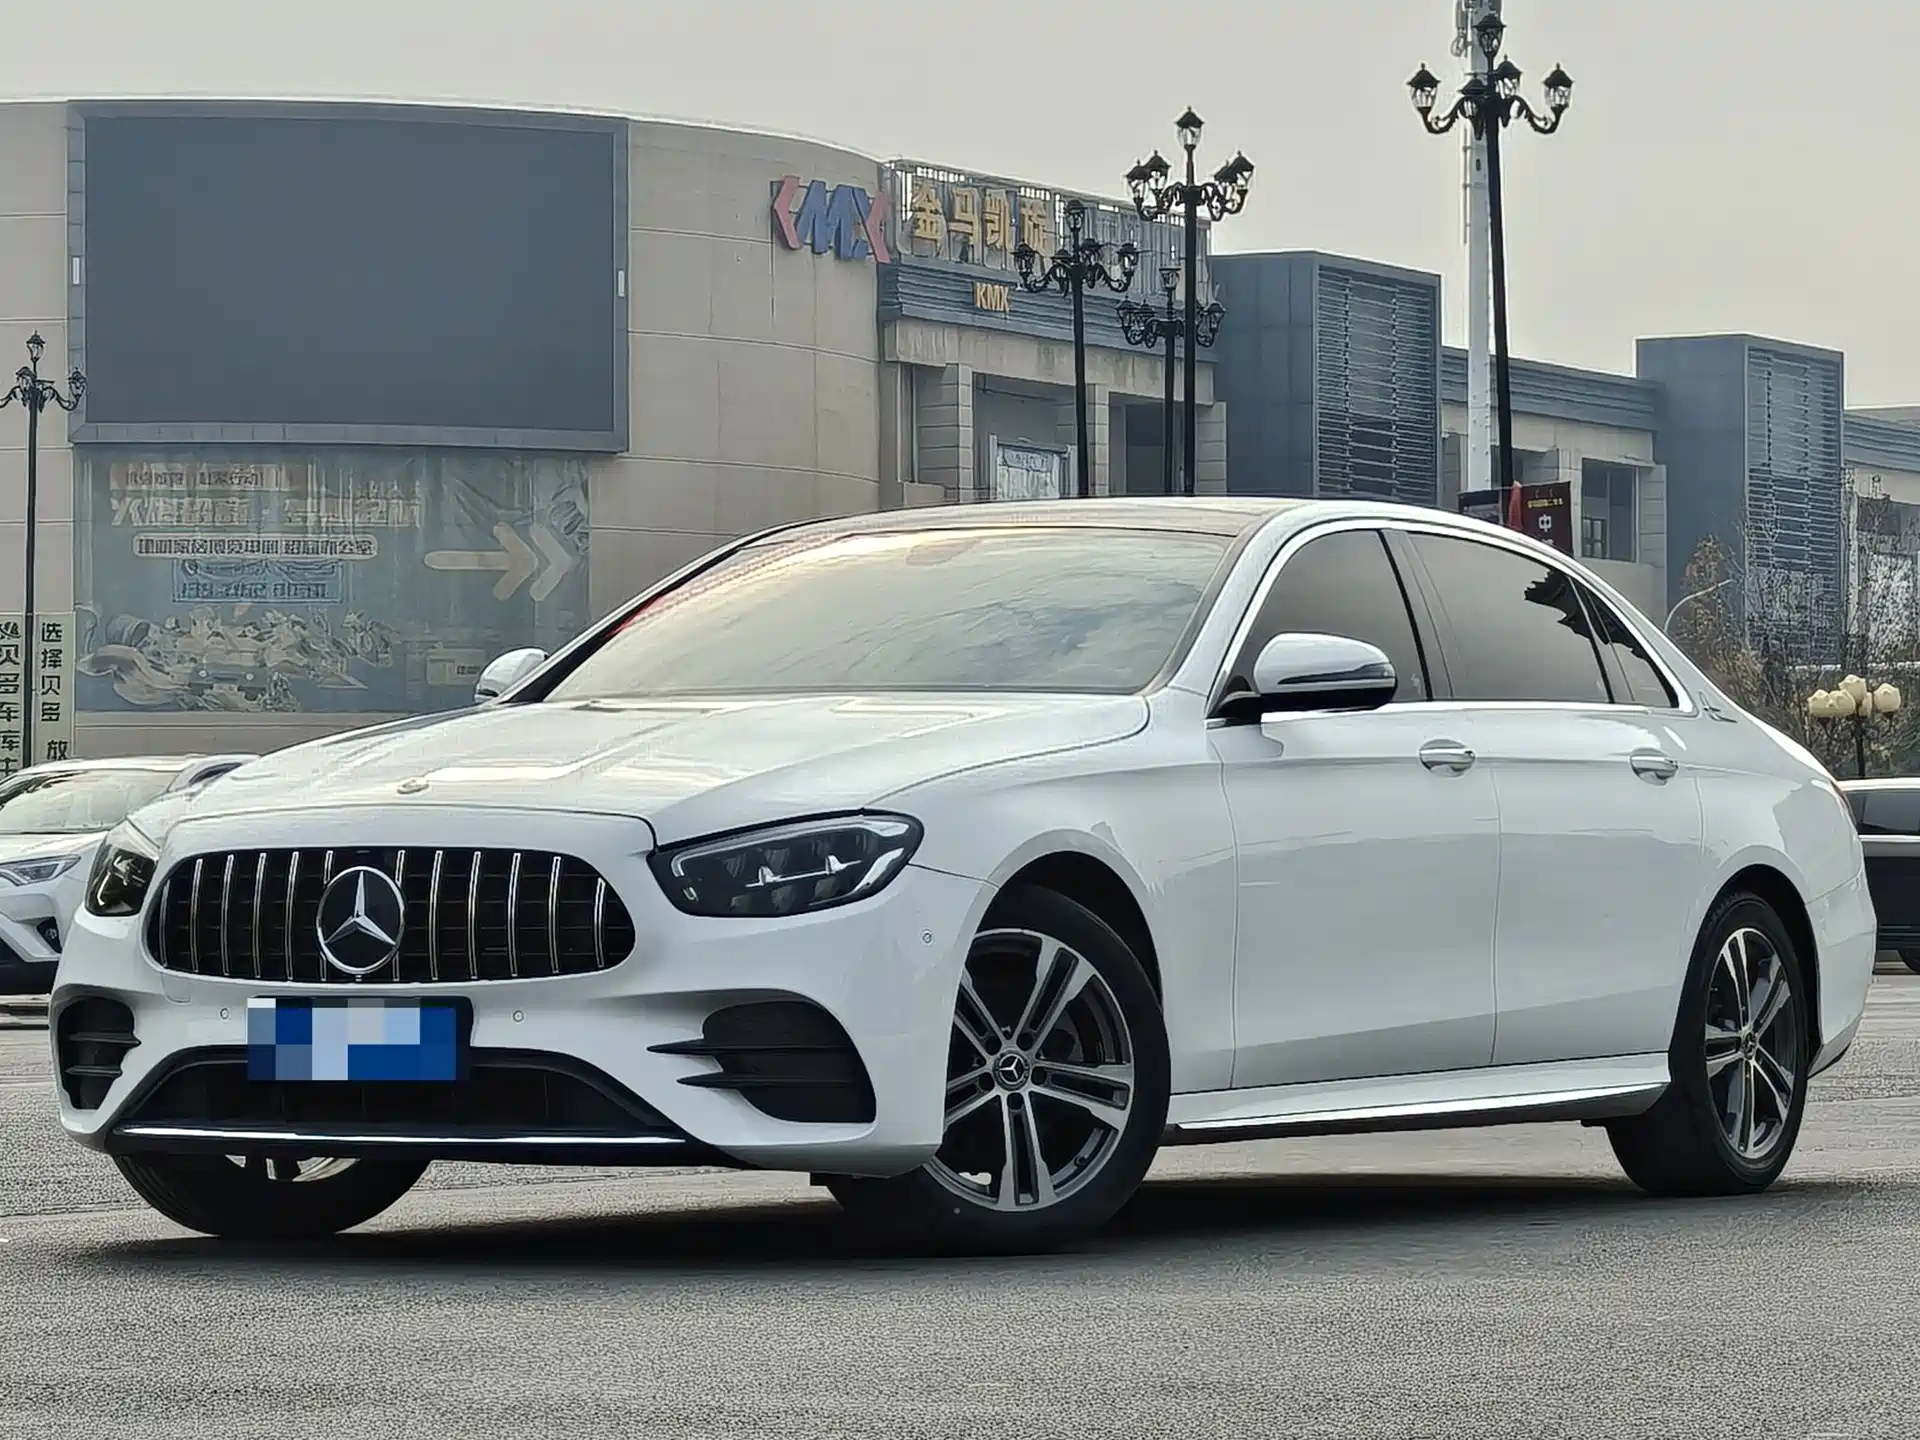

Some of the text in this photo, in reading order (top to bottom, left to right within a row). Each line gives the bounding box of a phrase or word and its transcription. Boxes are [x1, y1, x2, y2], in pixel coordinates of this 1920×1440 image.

[911, 182, 1048, 253] 金马凯旋
[41, 622, 62, 722] 选择贝多
